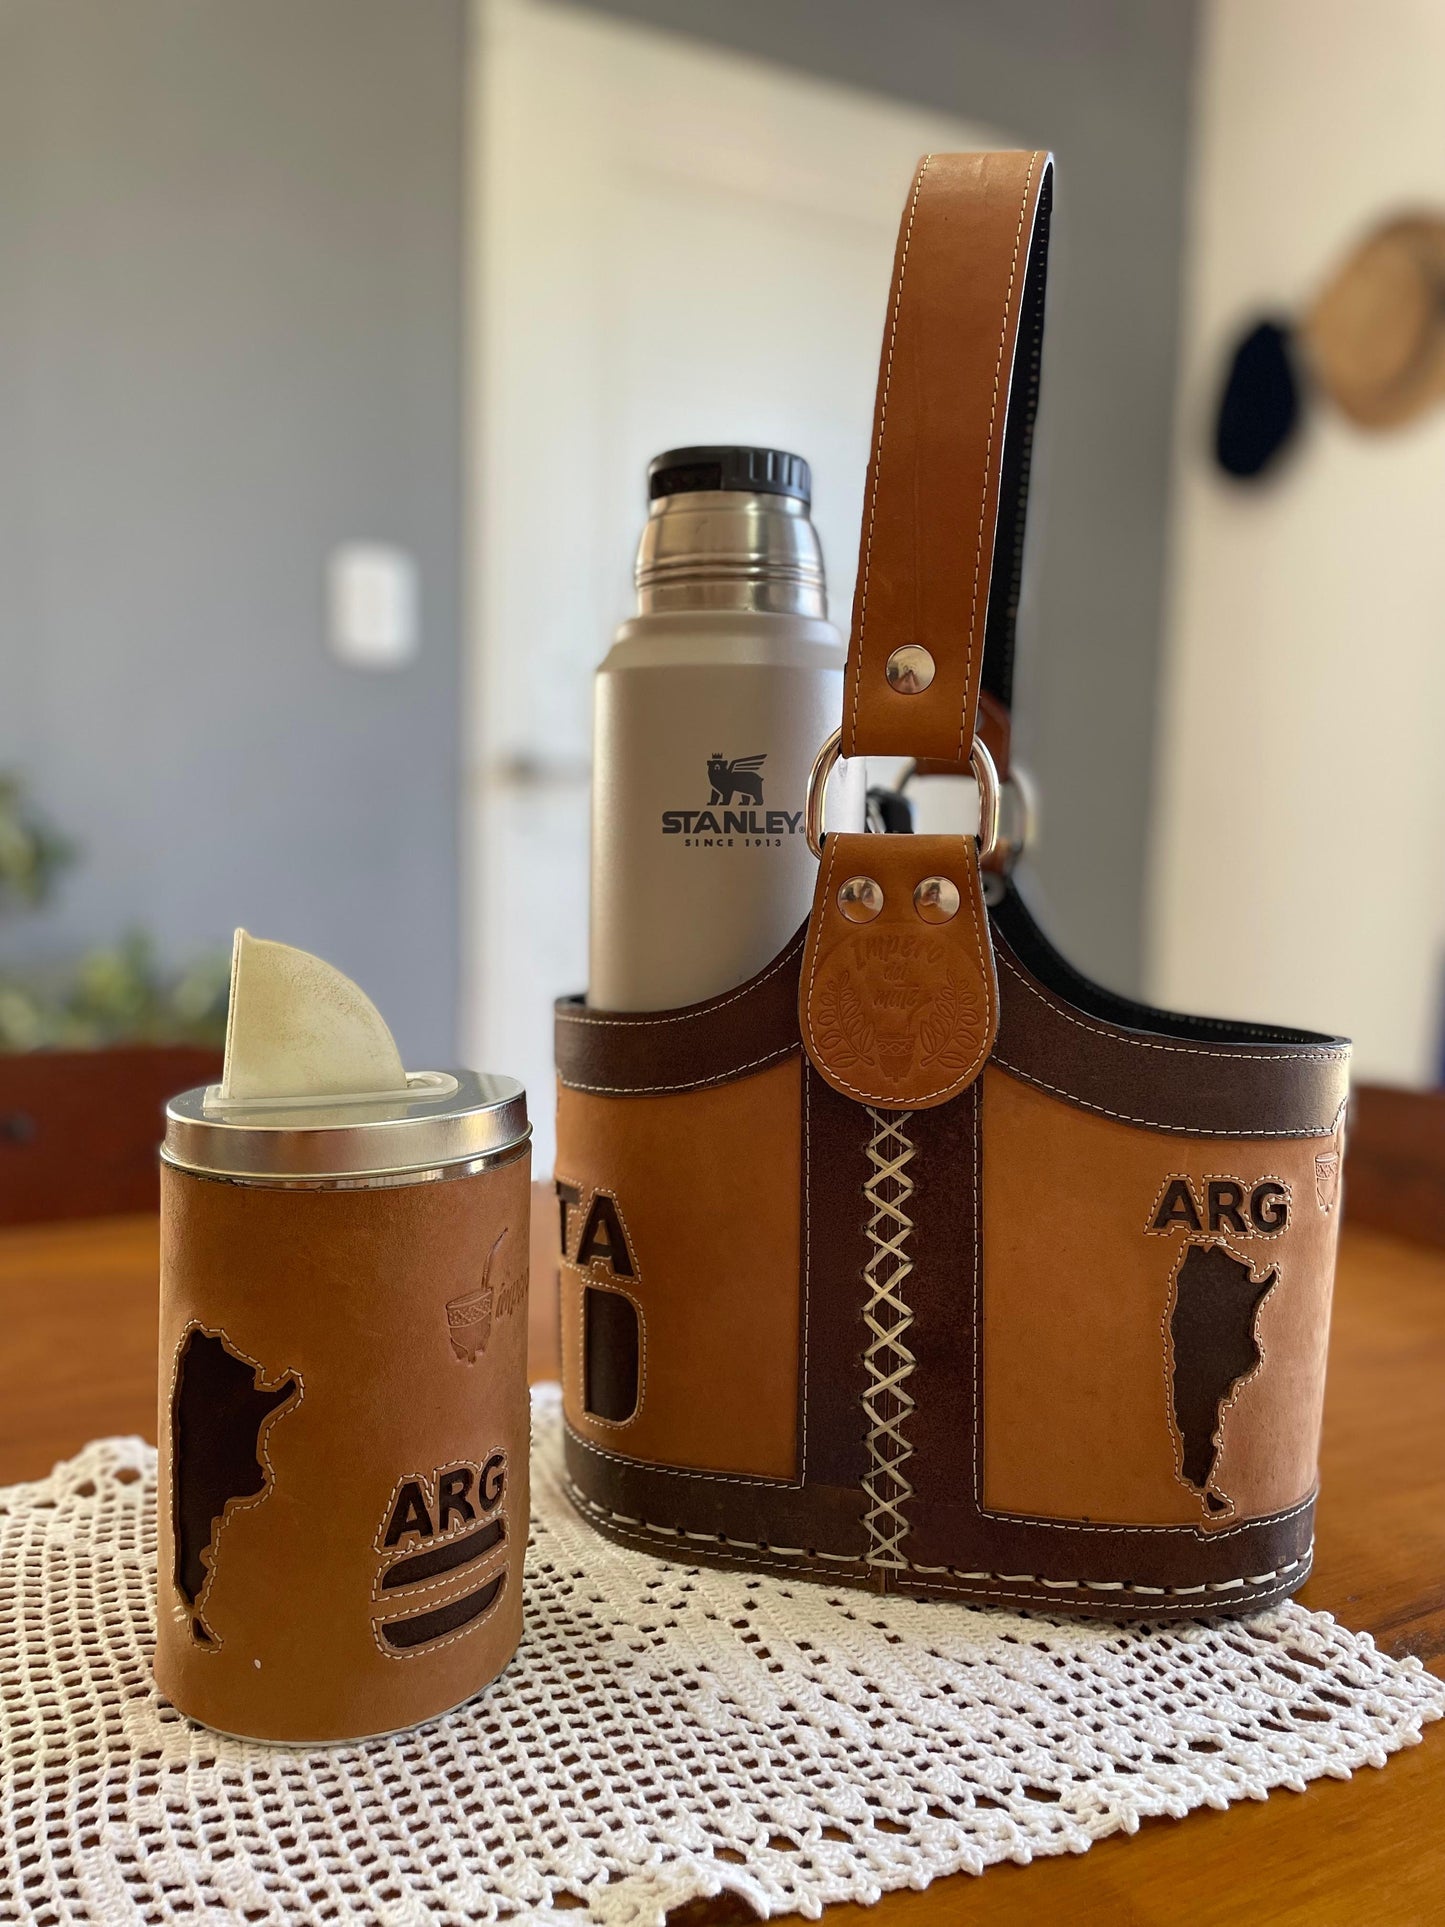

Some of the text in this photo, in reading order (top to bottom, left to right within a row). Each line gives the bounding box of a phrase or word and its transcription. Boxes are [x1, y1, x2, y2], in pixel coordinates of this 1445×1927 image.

[662, 811, 803, 834] STANLEY
[685, 838, 782, 847] SINCE 1913
[1152, 1180, 1288, 1233] ARG
[384, 1454, 506, 1547] ARG
